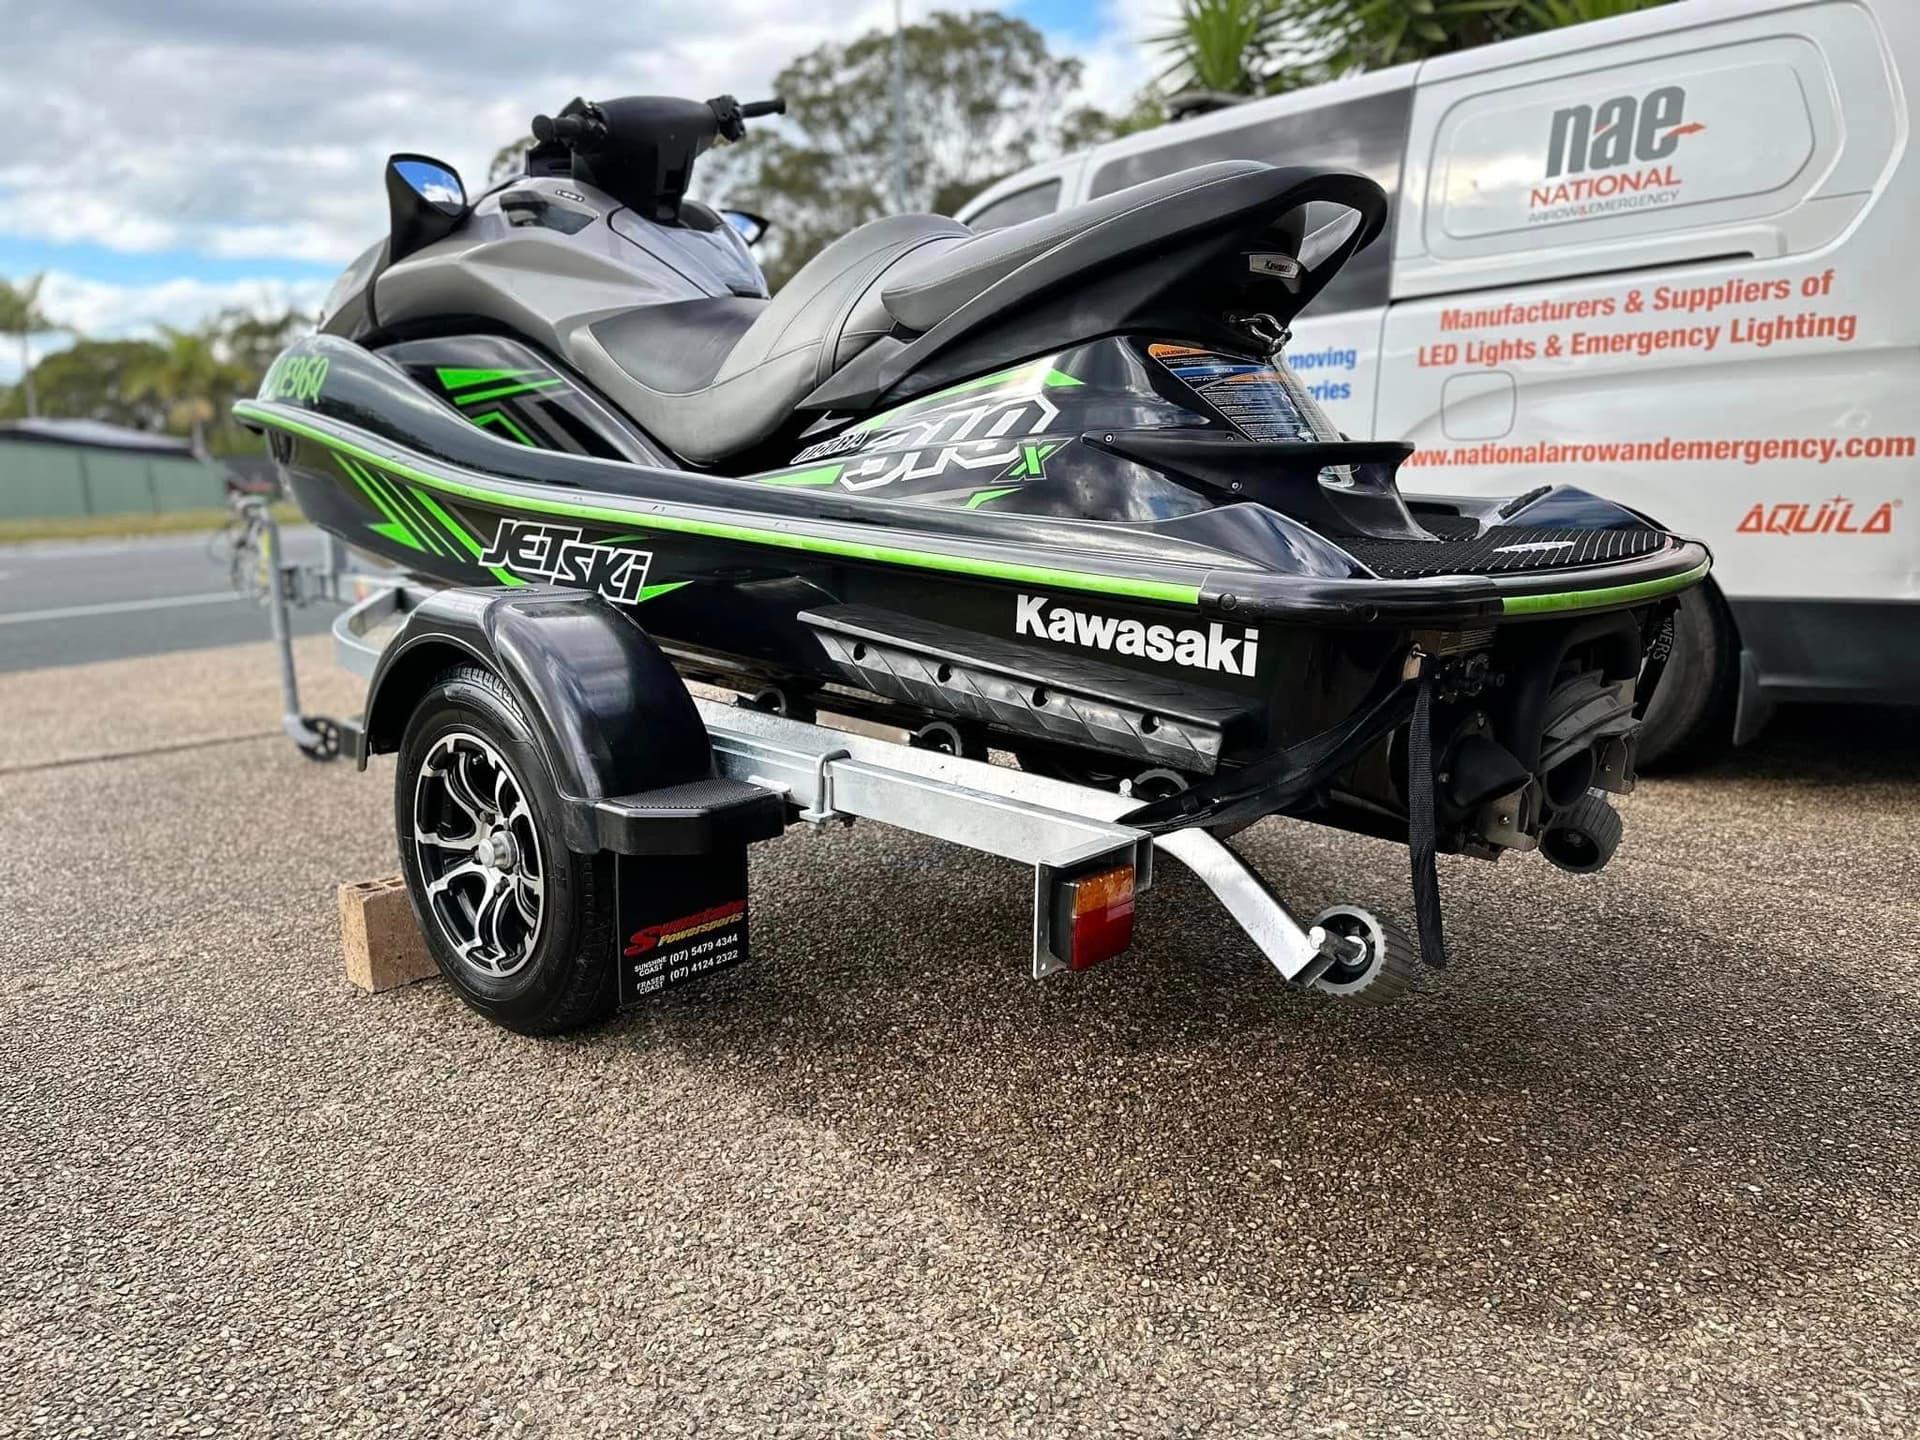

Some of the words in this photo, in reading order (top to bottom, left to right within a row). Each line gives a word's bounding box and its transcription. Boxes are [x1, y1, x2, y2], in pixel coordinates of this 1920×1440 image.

[1546, 86, 1686, 178] nae
[1530, 165, 1683, 208] NATIONAL
[1440, 298, 1615, 332] Manufacturers
[1624, 289, 1644, 314] &
[1653, 278, 1791, 313] Suppliers
[1801, 268, 1834, 298] of
[1418, 345, 1457, 367] LED
[1466, 338, 1536, 367] Lights
[1544, 333, 1563, 357] &
[1571, 326, 1721, 356] Emergency
[1730, 313, 1857, 347] Lighting
[1306, 380, 1351, 401] ries
[1015, 593, 1260, 678] Kawasaki
[634, 955, 668, 973] SUNSHINE
[669, 949, 689, 965] (07)
[691, 941, 714, 957] 5479
[715, 933, 738, 947] 4344
[639, 963, 663, 977] COAST
[670, 967, 689, 982] (07)
[691, 957, 714, 973] 4124
[716, 949, 739, 965] 2322
[636, 974, 665, 991] FRASER
[639, 981, 664, 995] COAST
